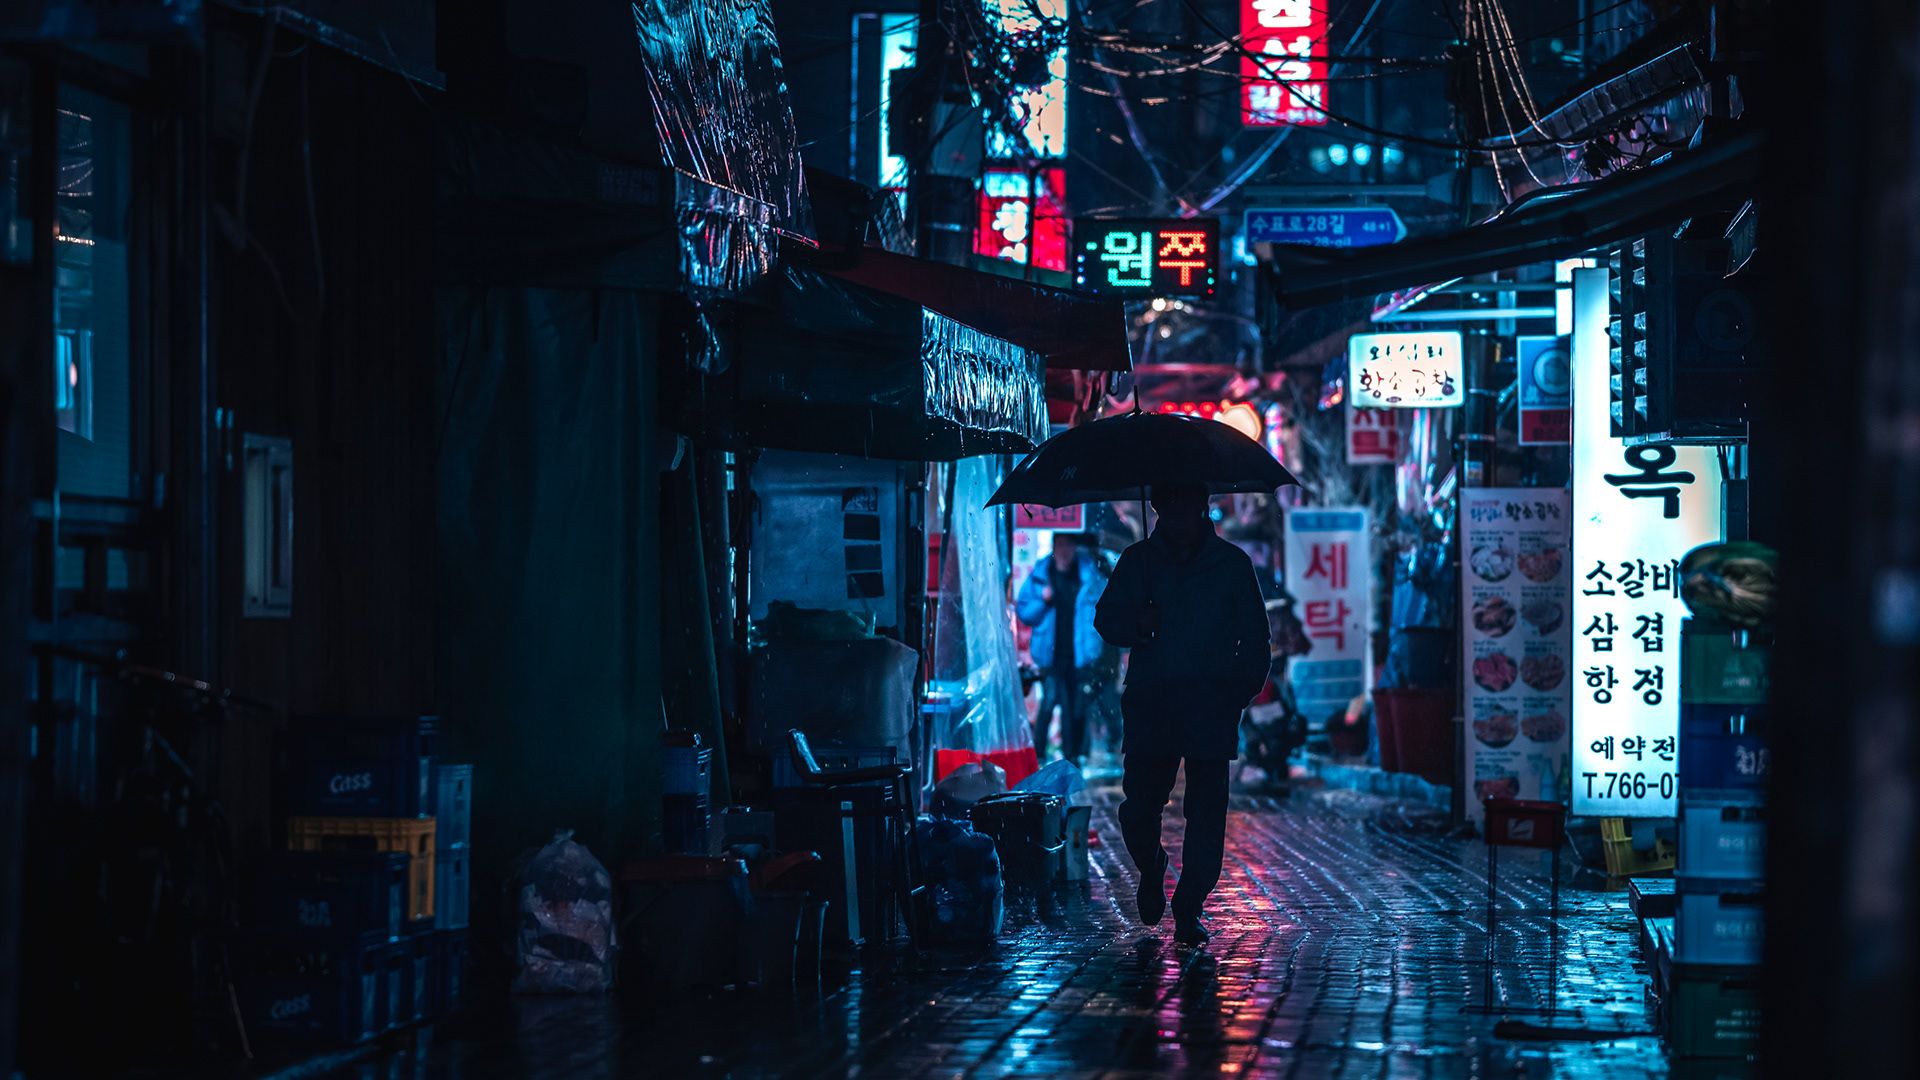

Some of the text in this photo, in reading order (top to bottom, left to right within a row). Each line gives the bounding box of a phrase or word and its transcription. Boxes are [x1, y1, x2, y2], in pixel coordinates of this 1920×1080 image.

[1603, 444, 1696, 519] 옥
[1303, 543, 1351, 650] 세탁
[1582, 559, 1680, 599] 소갈비
[329, 772, 372, 794] Cass
